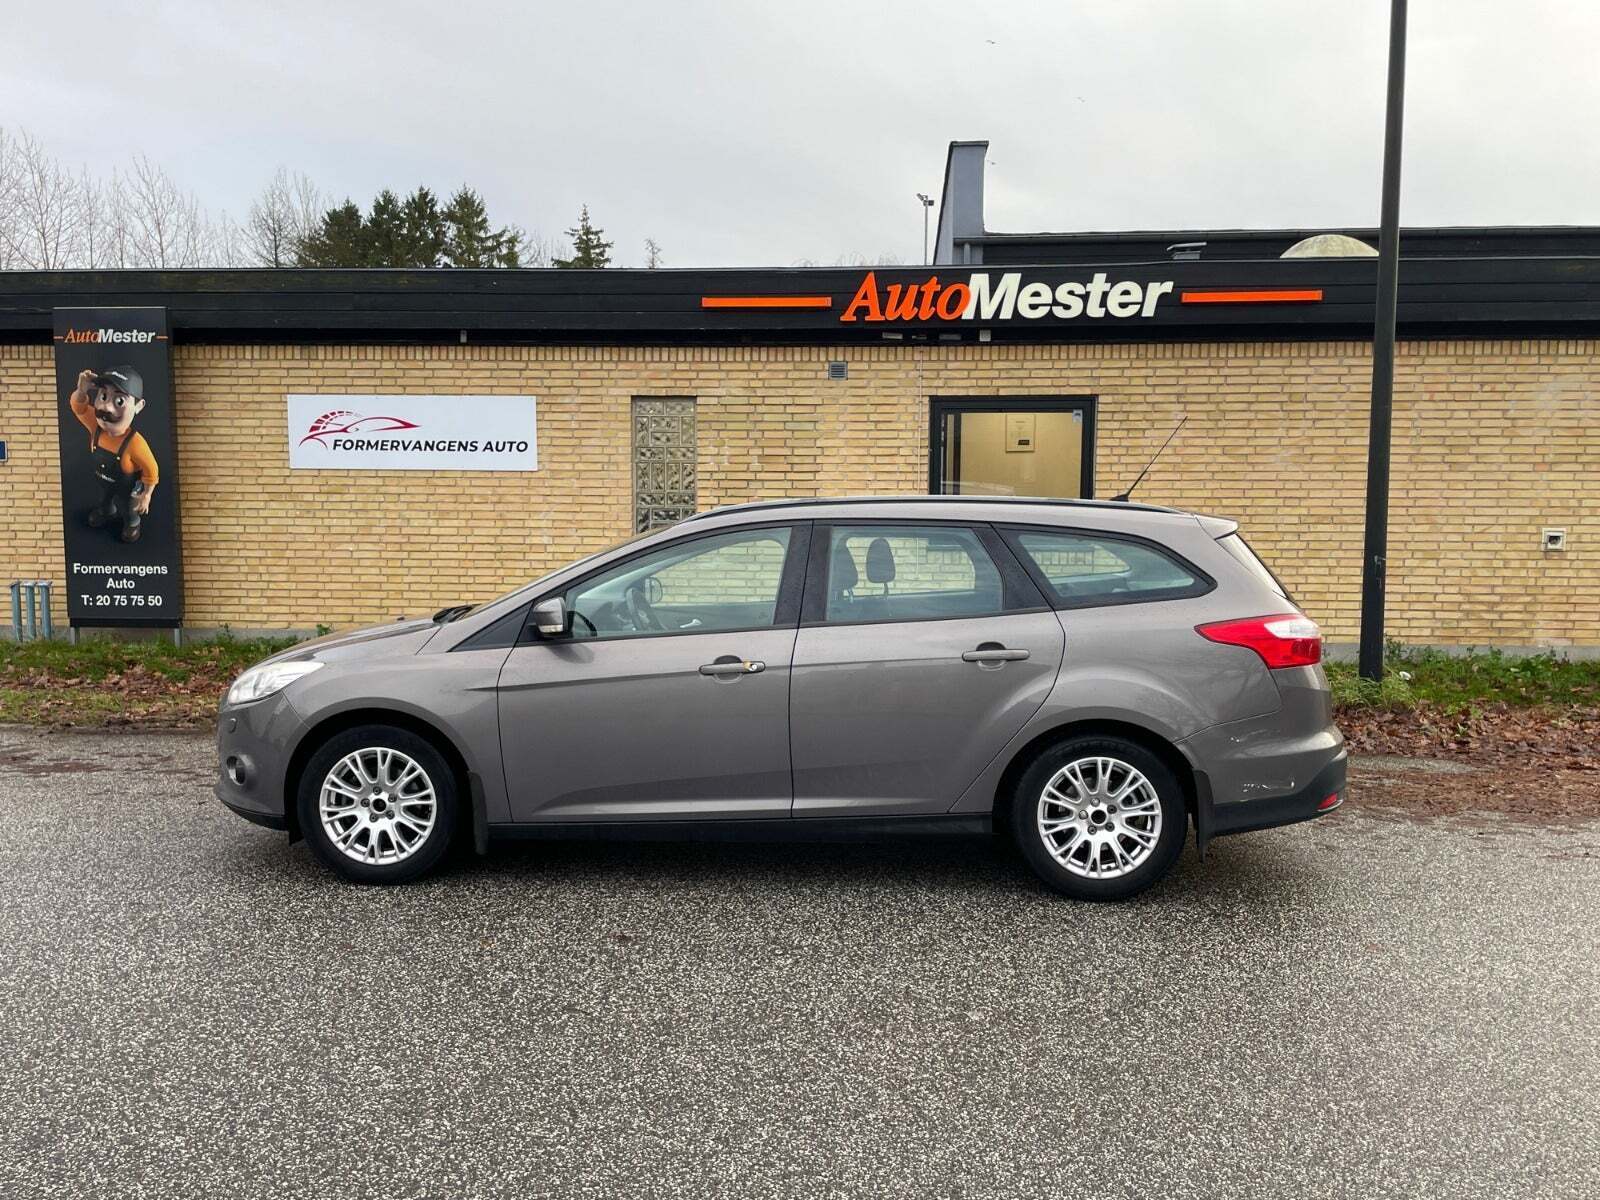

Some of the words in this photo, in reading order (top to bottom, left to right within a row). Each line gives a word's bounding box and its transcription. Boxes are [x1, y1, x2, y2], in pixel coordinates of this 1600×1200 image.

[840, 271, 1174, 321] AutoMester
[64, 328, 155, 343] AutoMester
[332, 438, 478, 452] FORMERVANGENS
[482, 440, 529, 453] AUTO
[73, 563, 168, 577] Formervangens
[106, 577, 135, 589] Auto
[81, 595, 93, 606] T:
[96, 595, 110, 606] 20
[113, 595, 128, 606] 75
[130, 595, 145, 606] 75
[147, 595, 163, 606] 50
